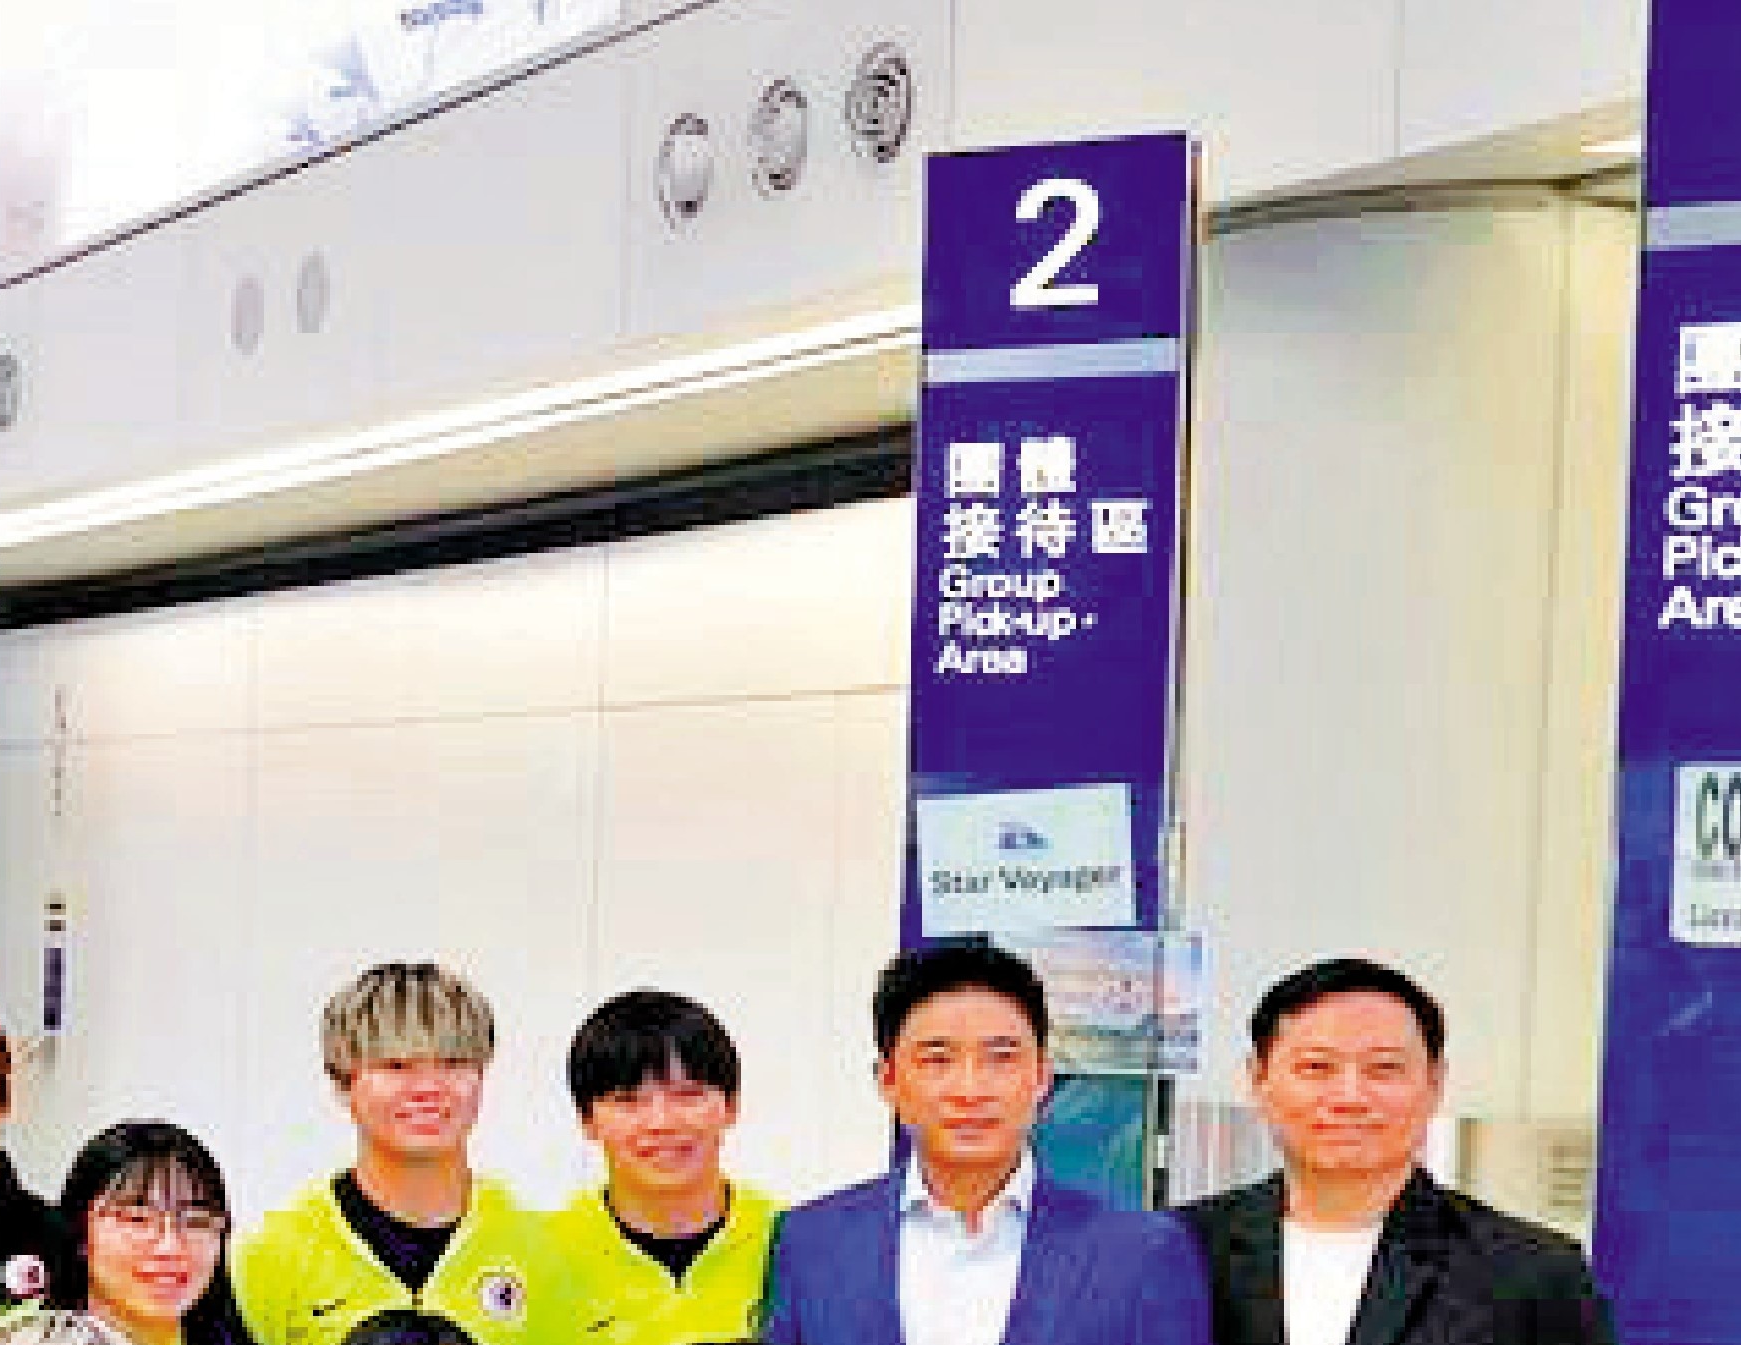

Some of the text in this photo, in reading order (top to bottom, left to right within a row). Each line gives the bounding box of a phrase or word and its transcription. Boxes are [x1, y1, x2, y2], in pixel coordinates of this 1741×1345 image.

[1010, 179, 1099, 308] 2
[943, 498, 1149, 558] 接待區
[938, 563, 1065, 602] Group
[932, 641, 1028, 674] Area
[928, 870, 990, 894] Star
